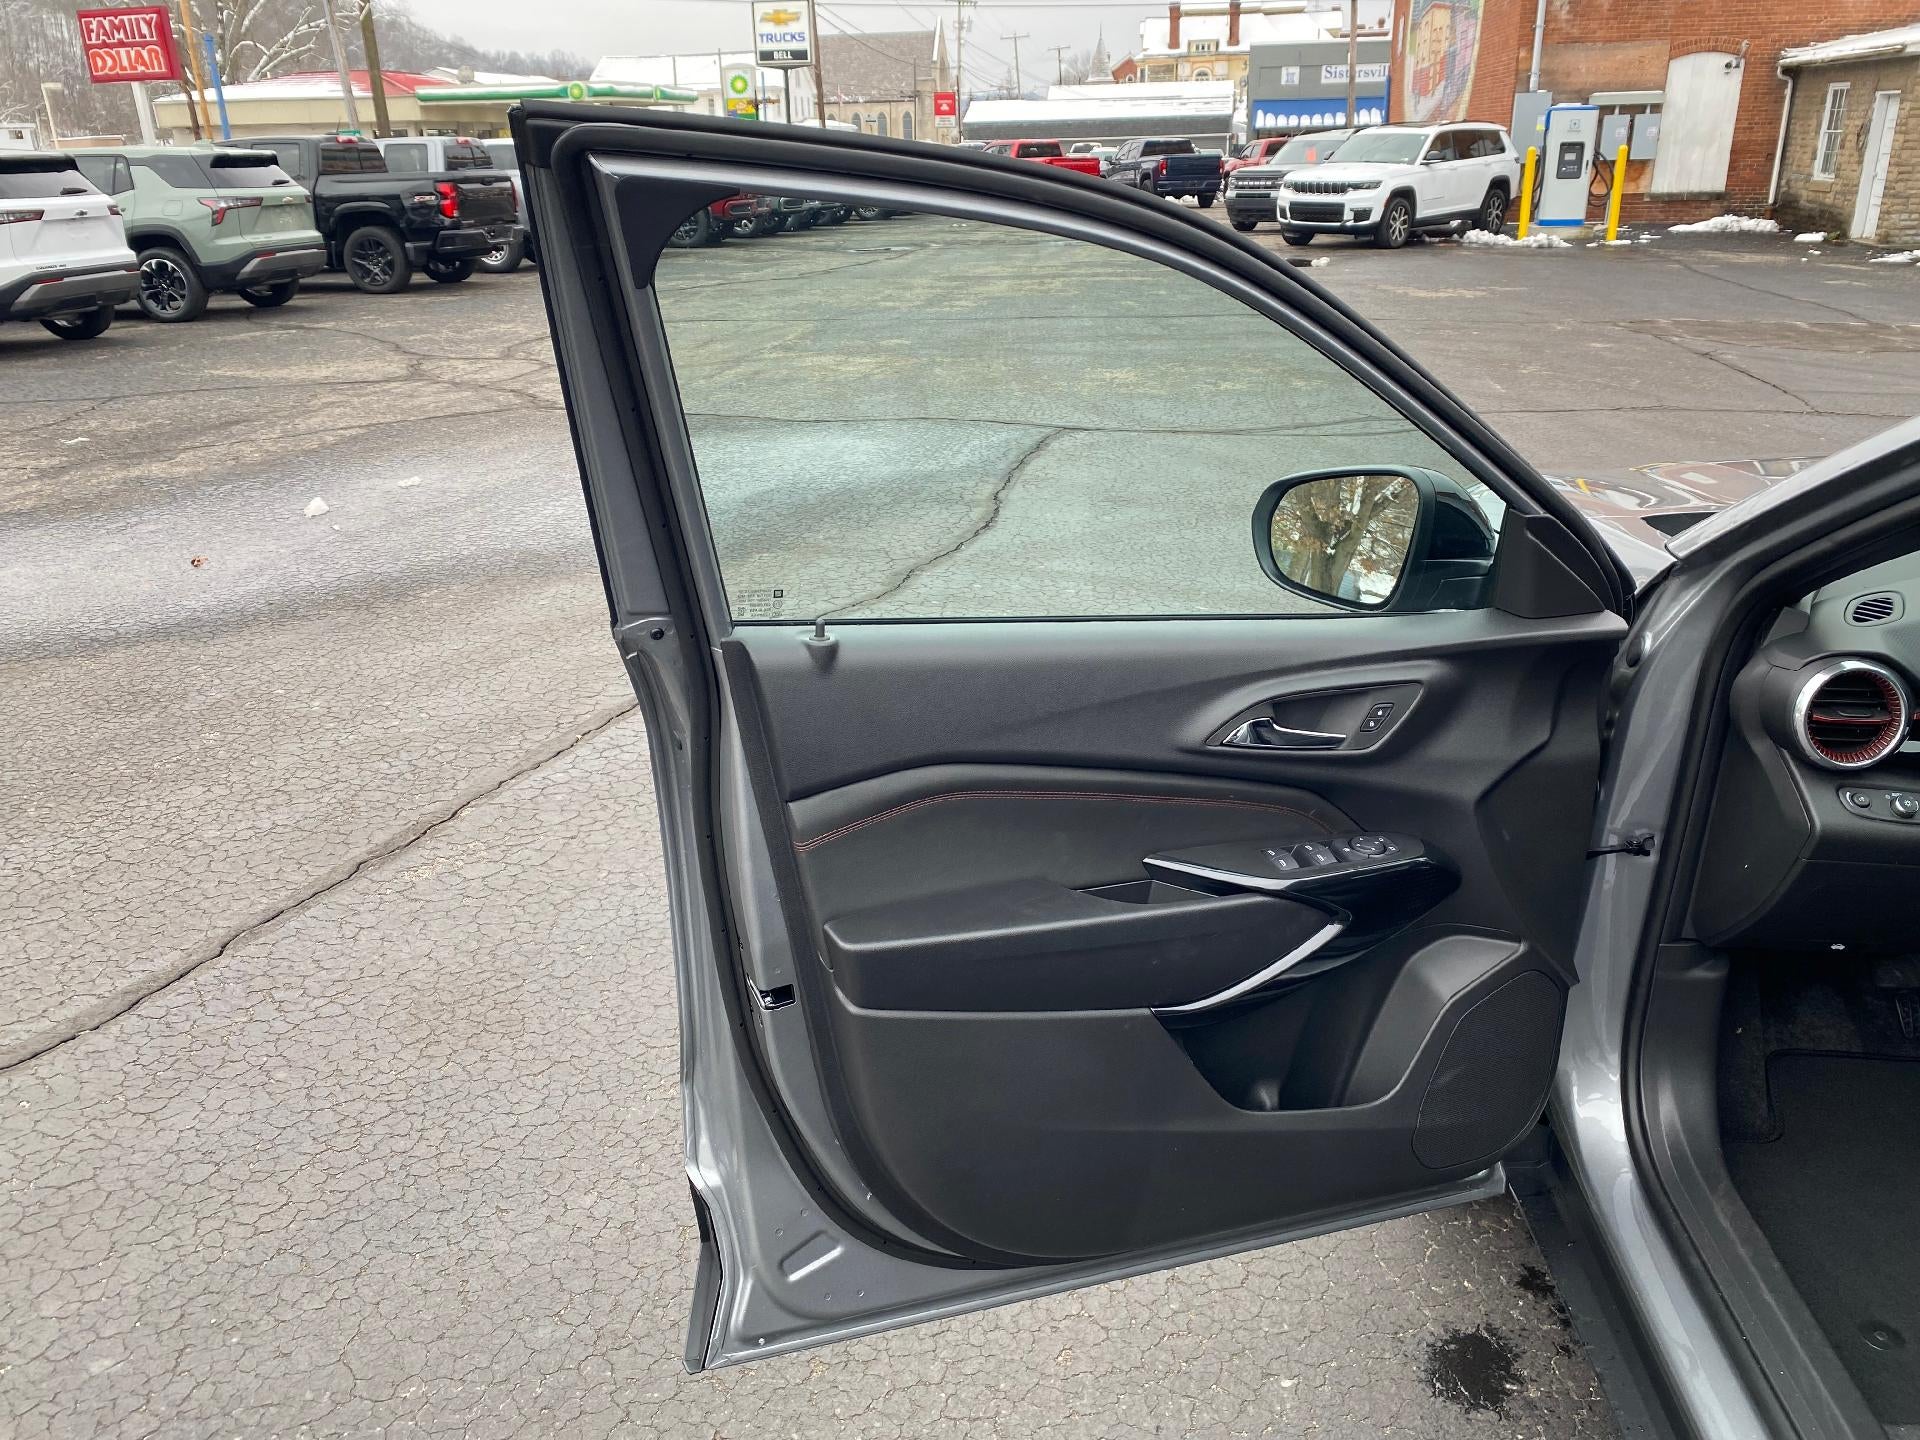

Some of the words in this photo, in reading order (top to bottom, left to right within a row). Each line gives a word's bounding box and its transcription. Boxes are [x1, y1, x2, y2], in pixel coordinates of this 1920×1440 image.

[82, 14, 158, 44] FAMILY
[758, 31, 806, 43] TRUCKS
[89, 45, 166, 75] DOLLAR
[773, 50, 793, 60] BELL
[1324, 64, 1387, 79] Sistrsvil
